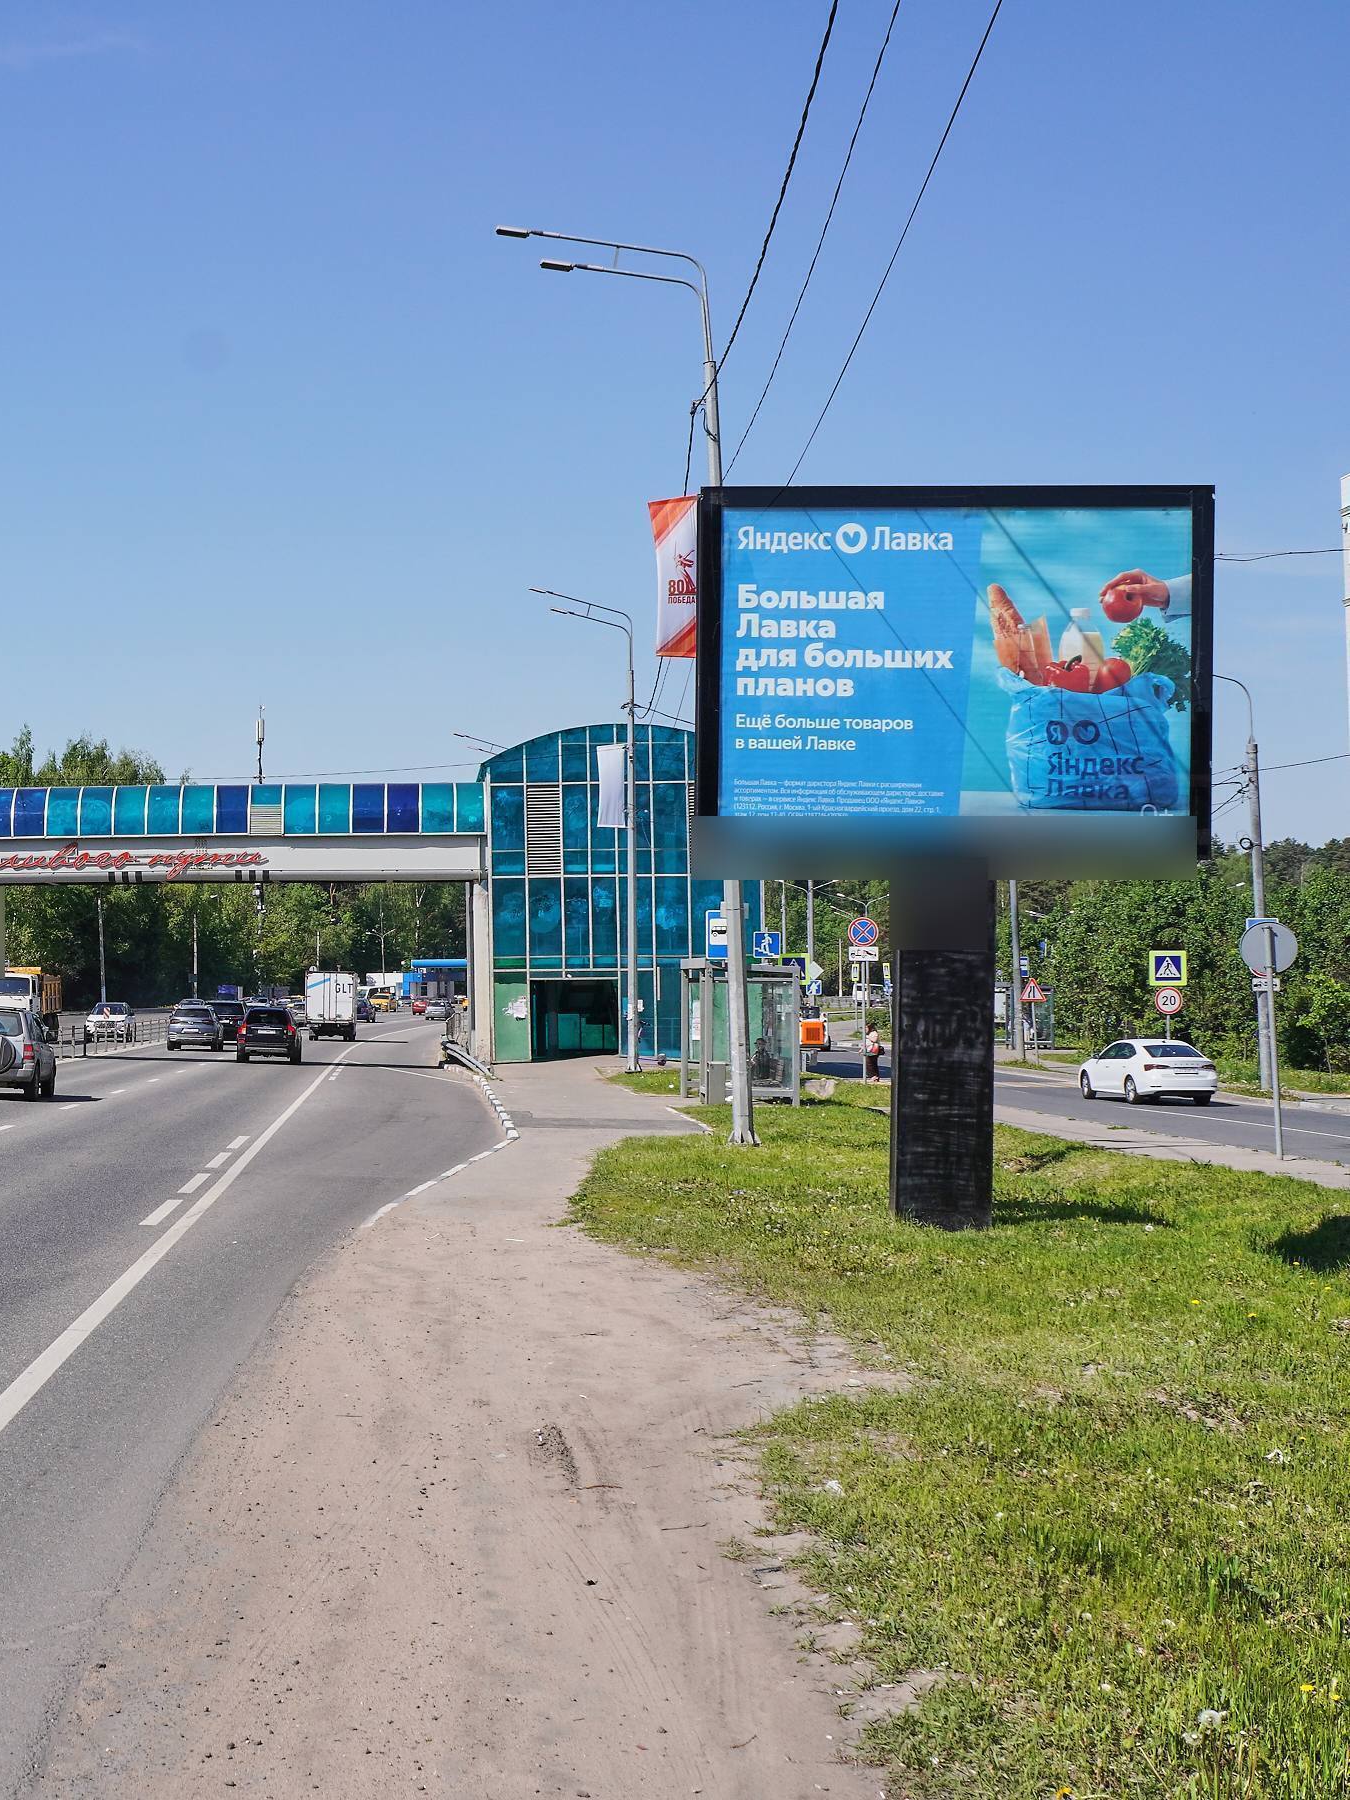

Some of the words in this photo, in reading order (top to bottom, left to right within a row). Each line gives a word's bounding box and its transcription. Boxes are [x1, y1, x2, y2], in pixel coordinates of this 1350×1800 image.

[737, 525, 832, 554] Яндекс
[871, 526, 954, 551] Лавка
[668, 579, 685, 594] 80
[737, 584, 885, 610] Большая
[736, 613, 837, 639] Лавка
[736, 648, 797, 672] для
[804, 642, 954, 669] больших
[736, 677, 855, 697] планов
[735, 714, 772, 730] Ещё
[774, 715, 841, 729] больше
[843, 718, 914, 733] товаров
[735, 738, 745, 749] в
[748, 736, 802, 750] вашей
[805, 736, 856, 751] Лавке
[1047, 752, 1145, 780] Яндекс
[148, 850, 270, 881] пути
[335, 983, 353, 993] GLT
[1162, 996, 1176, 1006] 20
